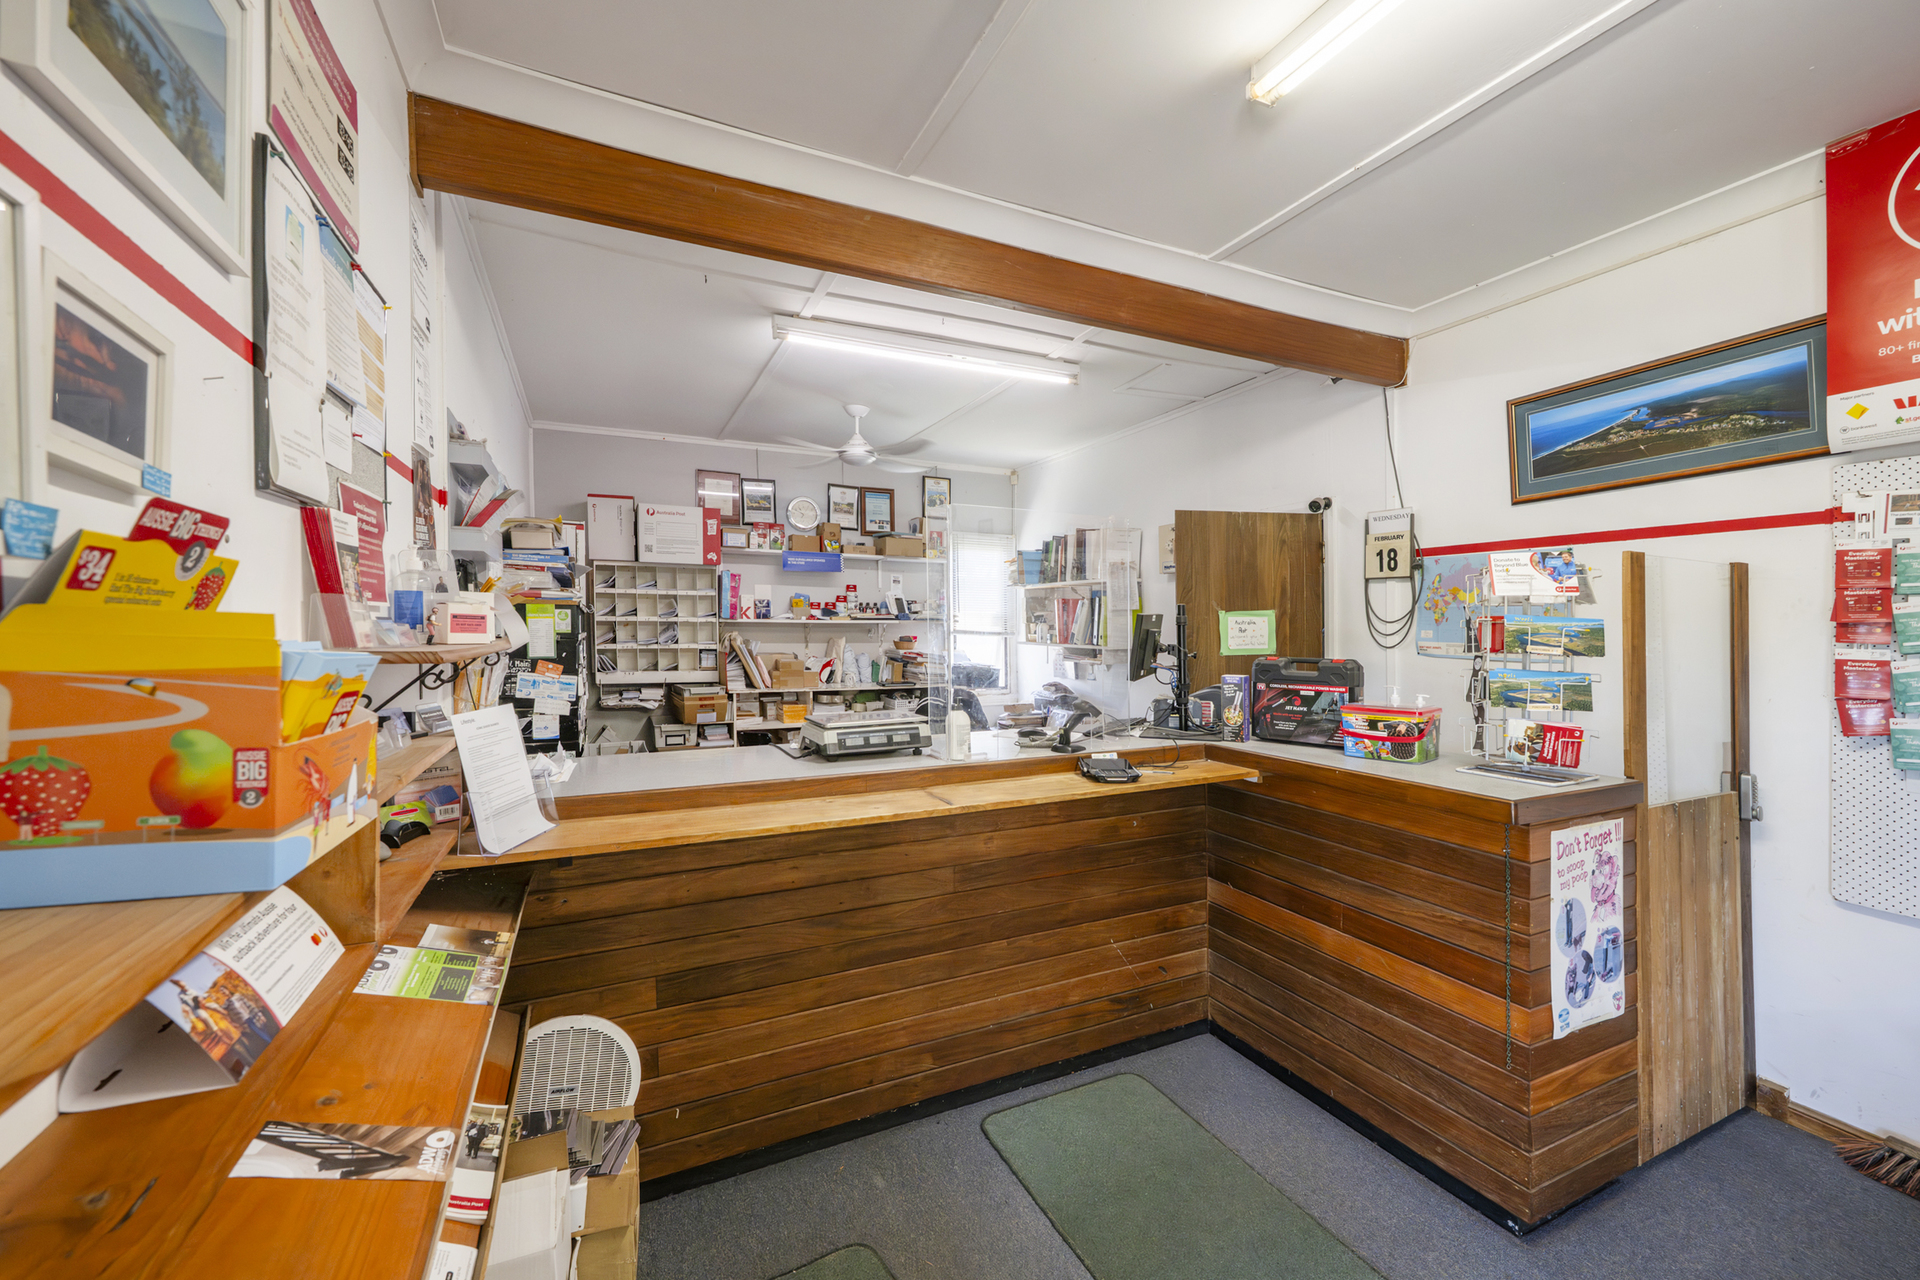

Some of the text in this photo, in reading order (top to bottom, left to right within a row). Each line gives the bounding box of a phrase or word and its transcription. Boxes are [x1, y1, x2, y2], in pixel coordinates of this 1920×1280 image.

[138, 506, 224, 540] AUSSIE BIG THINGS
[1373, 512, 1410, 522] WEDNESDAY
[78, 548, 112, 582] $34
[184, 547, 200, 568] 2
[1376, 548, 1398, 572] 18
[333, 696, 358, 714] AUSSIE
[236, 750, 267, 761] AUSSIE
[236, 761, 267, 780] BIG
[245, 792, 256, 803] 2
[1556, 836, 1582, 860] Don't
[1583, 828, 1613, 852] Forget
[1557, 860, 1585, 878] to scoop
[1560, 871, 1588, 890] my poop
[218, 936, 234, 952] Win
[240, 913, 262, 935] Ultimate
[258, 902, 278, 917] Aussie
[232, 941, 257, 963] outback
[254, 917, 282, 943] adventure
[417, 1146, 438, 1170] ADW
